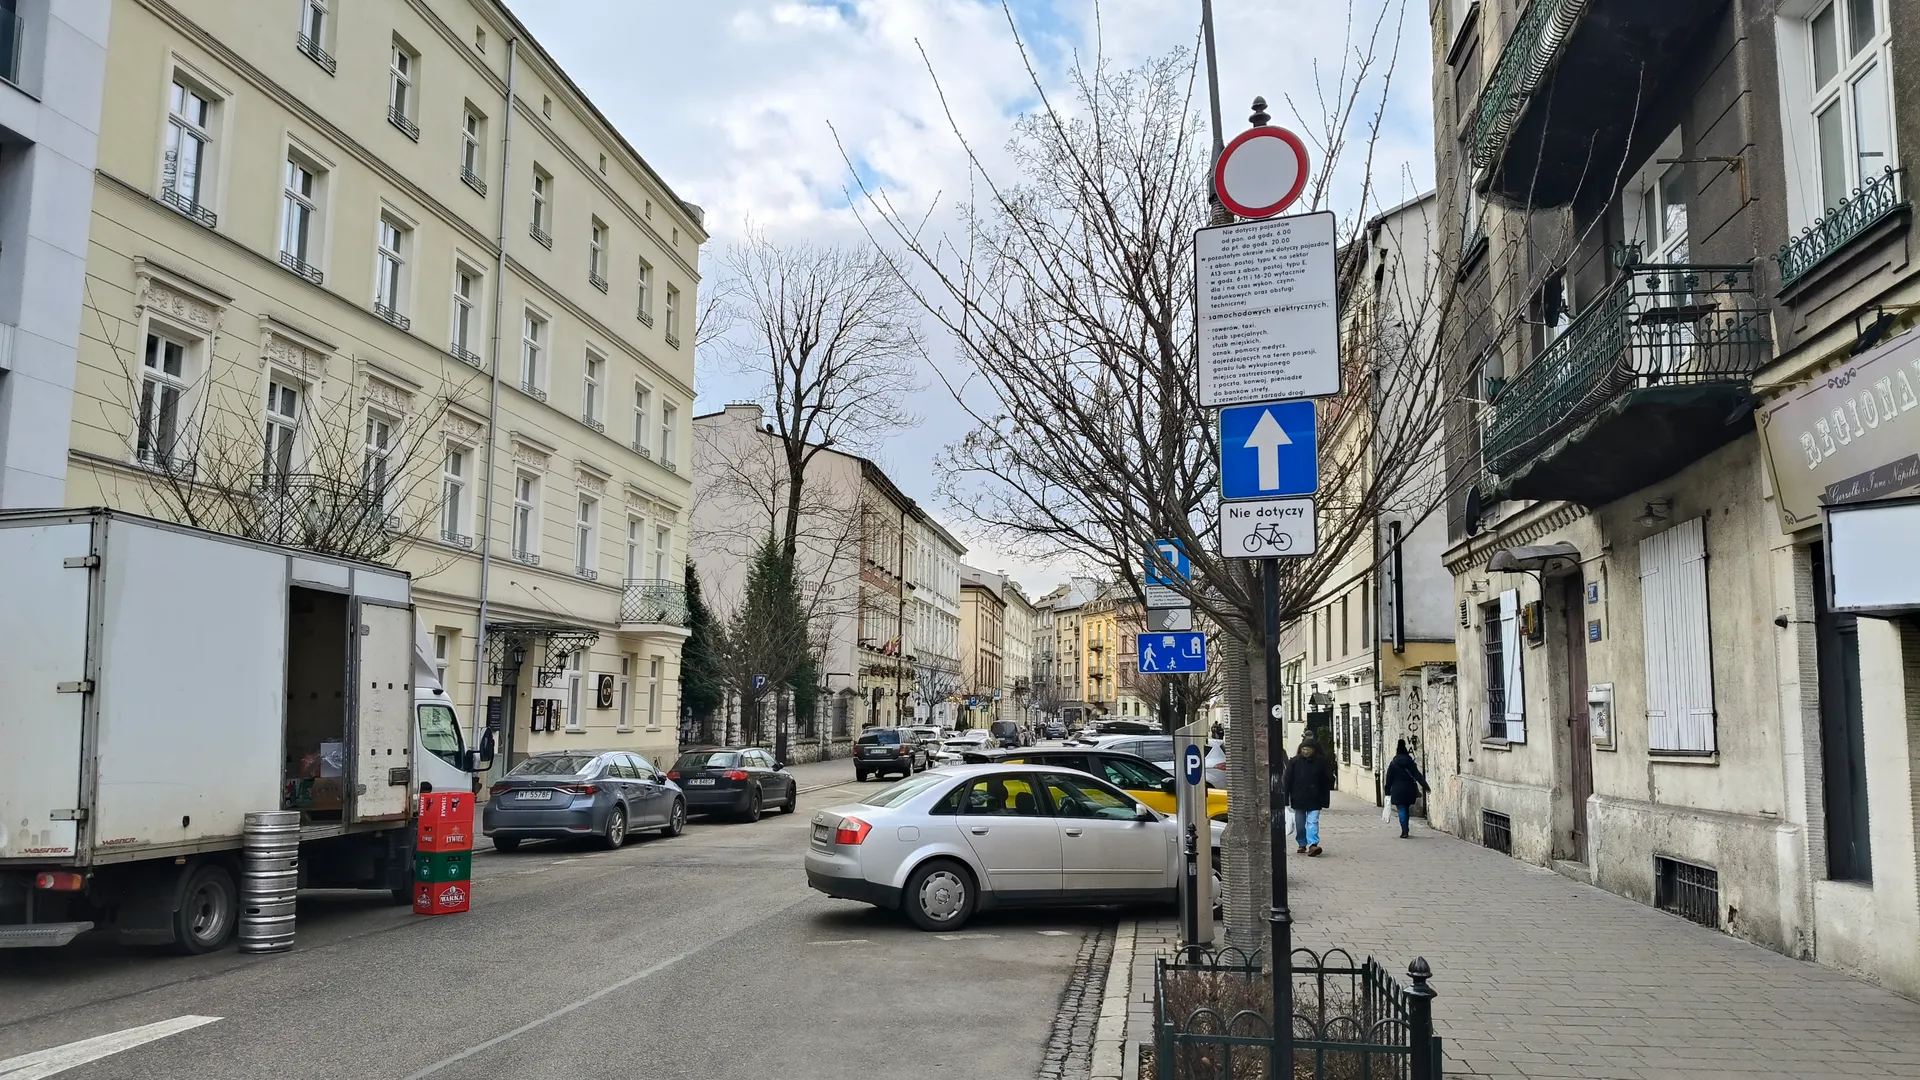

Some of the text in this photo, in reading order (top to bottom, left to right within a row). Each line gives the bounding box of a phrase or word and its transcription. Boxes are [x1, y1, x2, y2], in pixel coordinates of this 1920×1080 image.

[1235, 226, 1257, 234] dotyczy
[1272, 237, 1290, 245] 20.00
[1243, 249, 1263, 257] okresie
[1277, 245, 1298, 253] dotyczy
[1254, 272, 1272, 280] 16-20
[1211, 300, 1246, 309] technicznej
[1209, 308, 1271, 321] samochodowych
[1235, 347, 1259, 355] pomocy
[1248, 360, 1290, 369] wykupionego
[1219, 394, 1258, 403] zezwoleniem
[1288, 389, 1305, 397] drogi
[1799, 358, 1920, 471] REGIONA
[1229, 506, 1304, 519] Nie dotyczy
[1187, 754, 1200, 775] P
